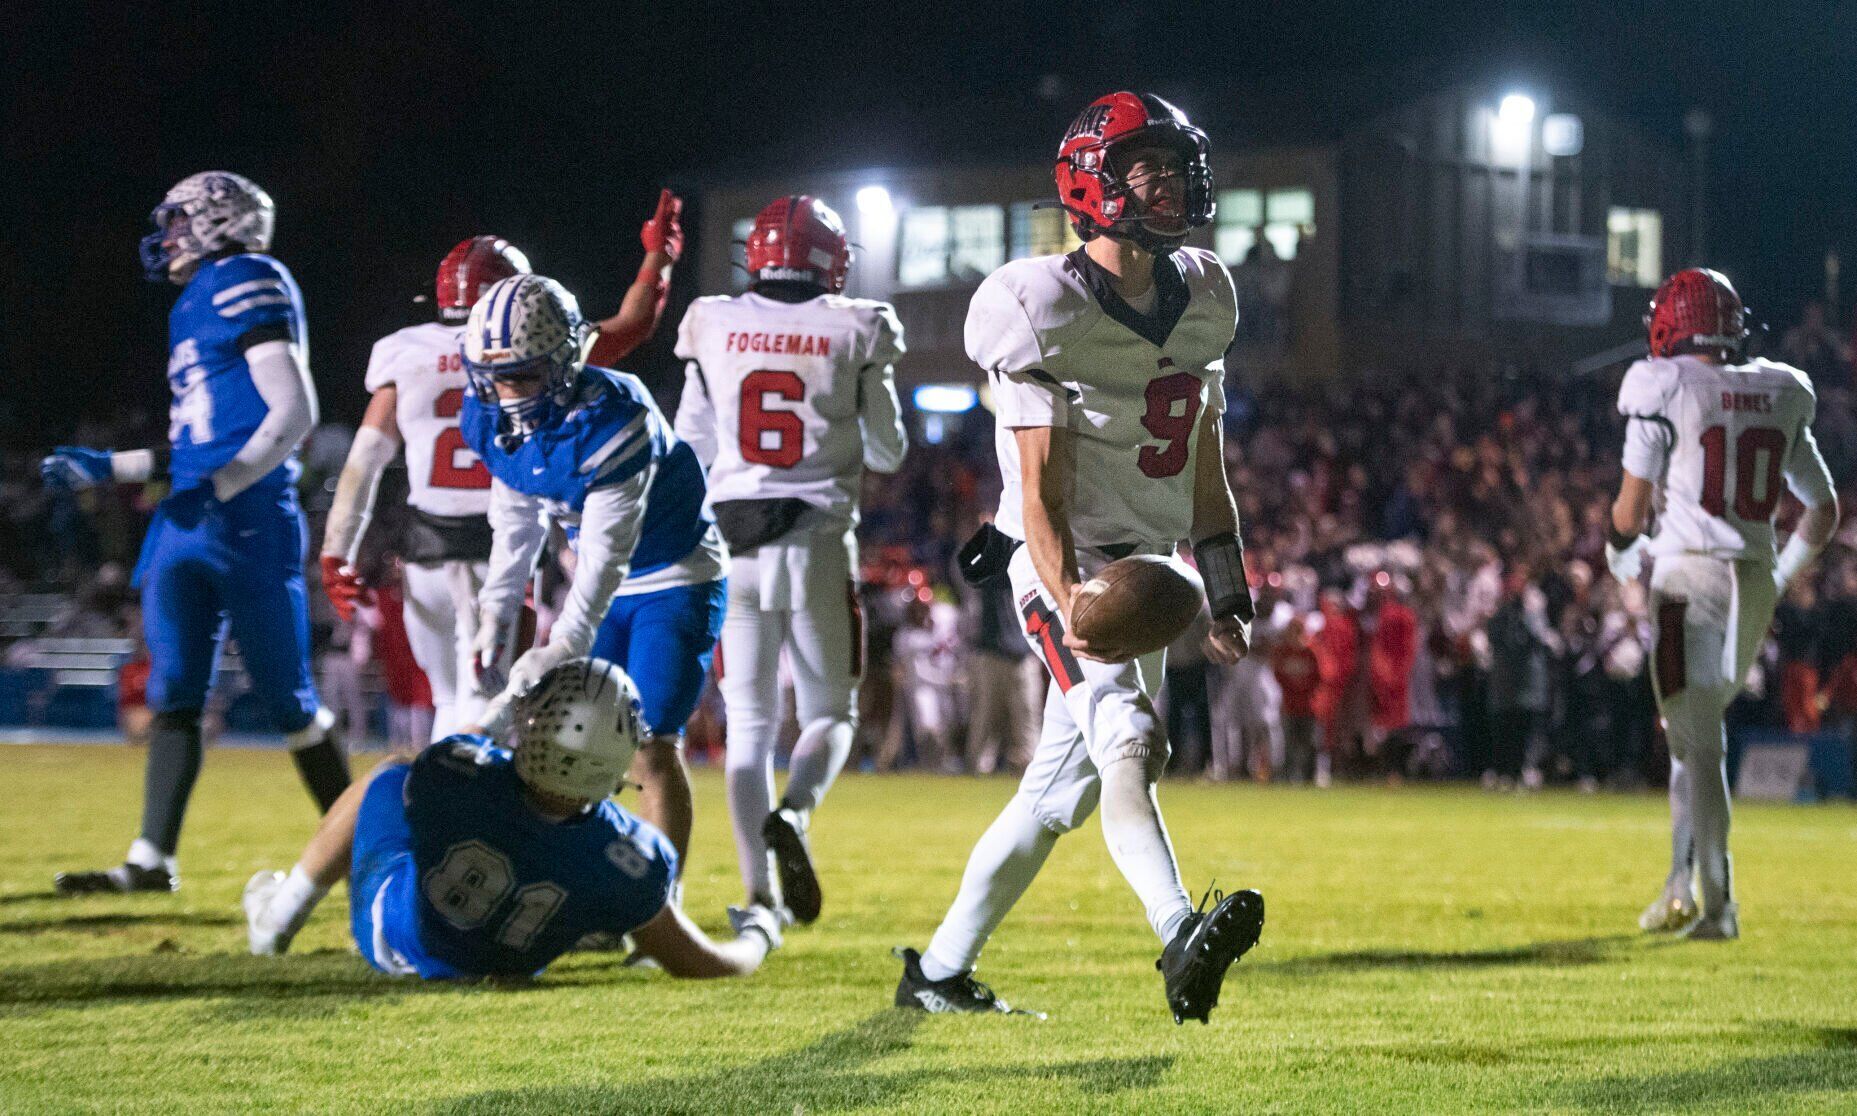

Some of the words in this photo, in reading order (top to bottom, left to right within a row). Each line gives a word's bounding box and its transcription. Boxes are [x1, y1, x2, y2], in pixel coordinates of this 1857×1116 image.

[726, 332, 831, 357] FOGLEMAN
[429, 388, 492, 489] 2
[740, 370, 804, 468] 6
[1137, 371, 1203, 479] 9
[1721, 391, 1772, 412] BENES
[1701, 423, 1788, 522] 10
[421, 838, 569, 951] 81
